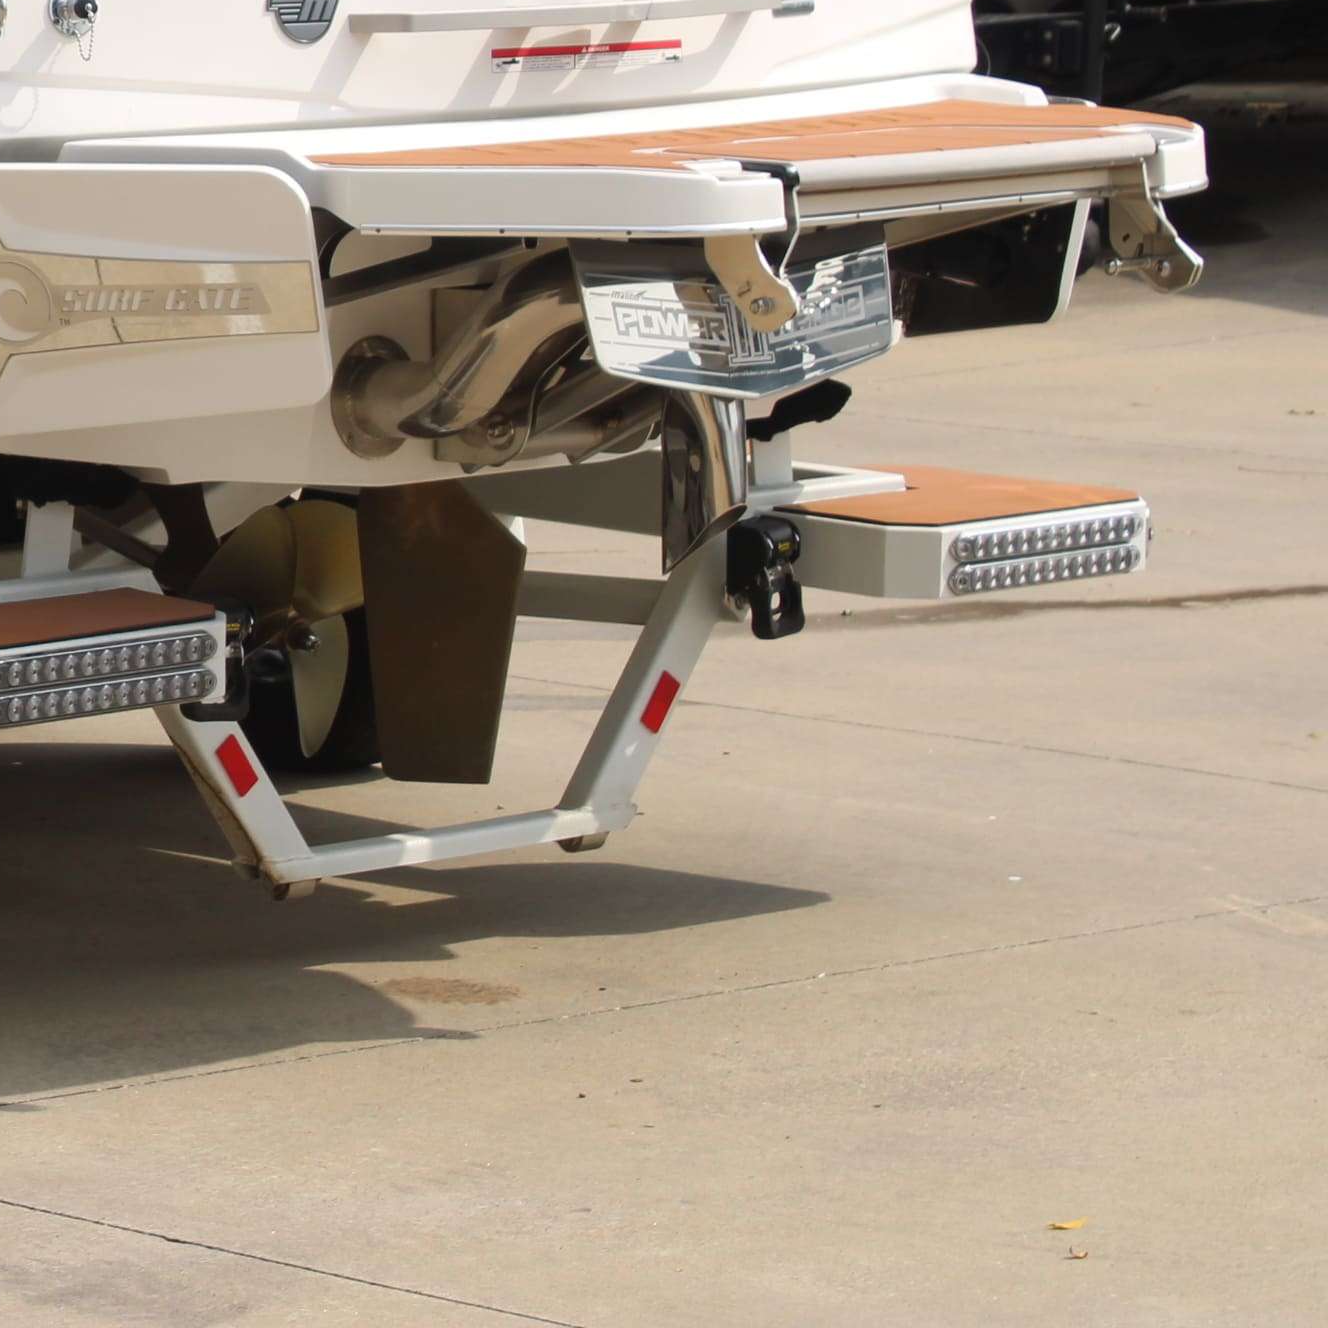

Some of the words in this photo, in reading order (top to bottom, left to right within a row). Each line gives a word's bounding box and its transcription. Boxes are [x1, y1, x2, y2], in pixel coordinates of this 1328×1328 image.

[61, 288, 155, 312] SURF
[164, 287, 255, 311] GATE
[615, 306, 728, 343] POWER
